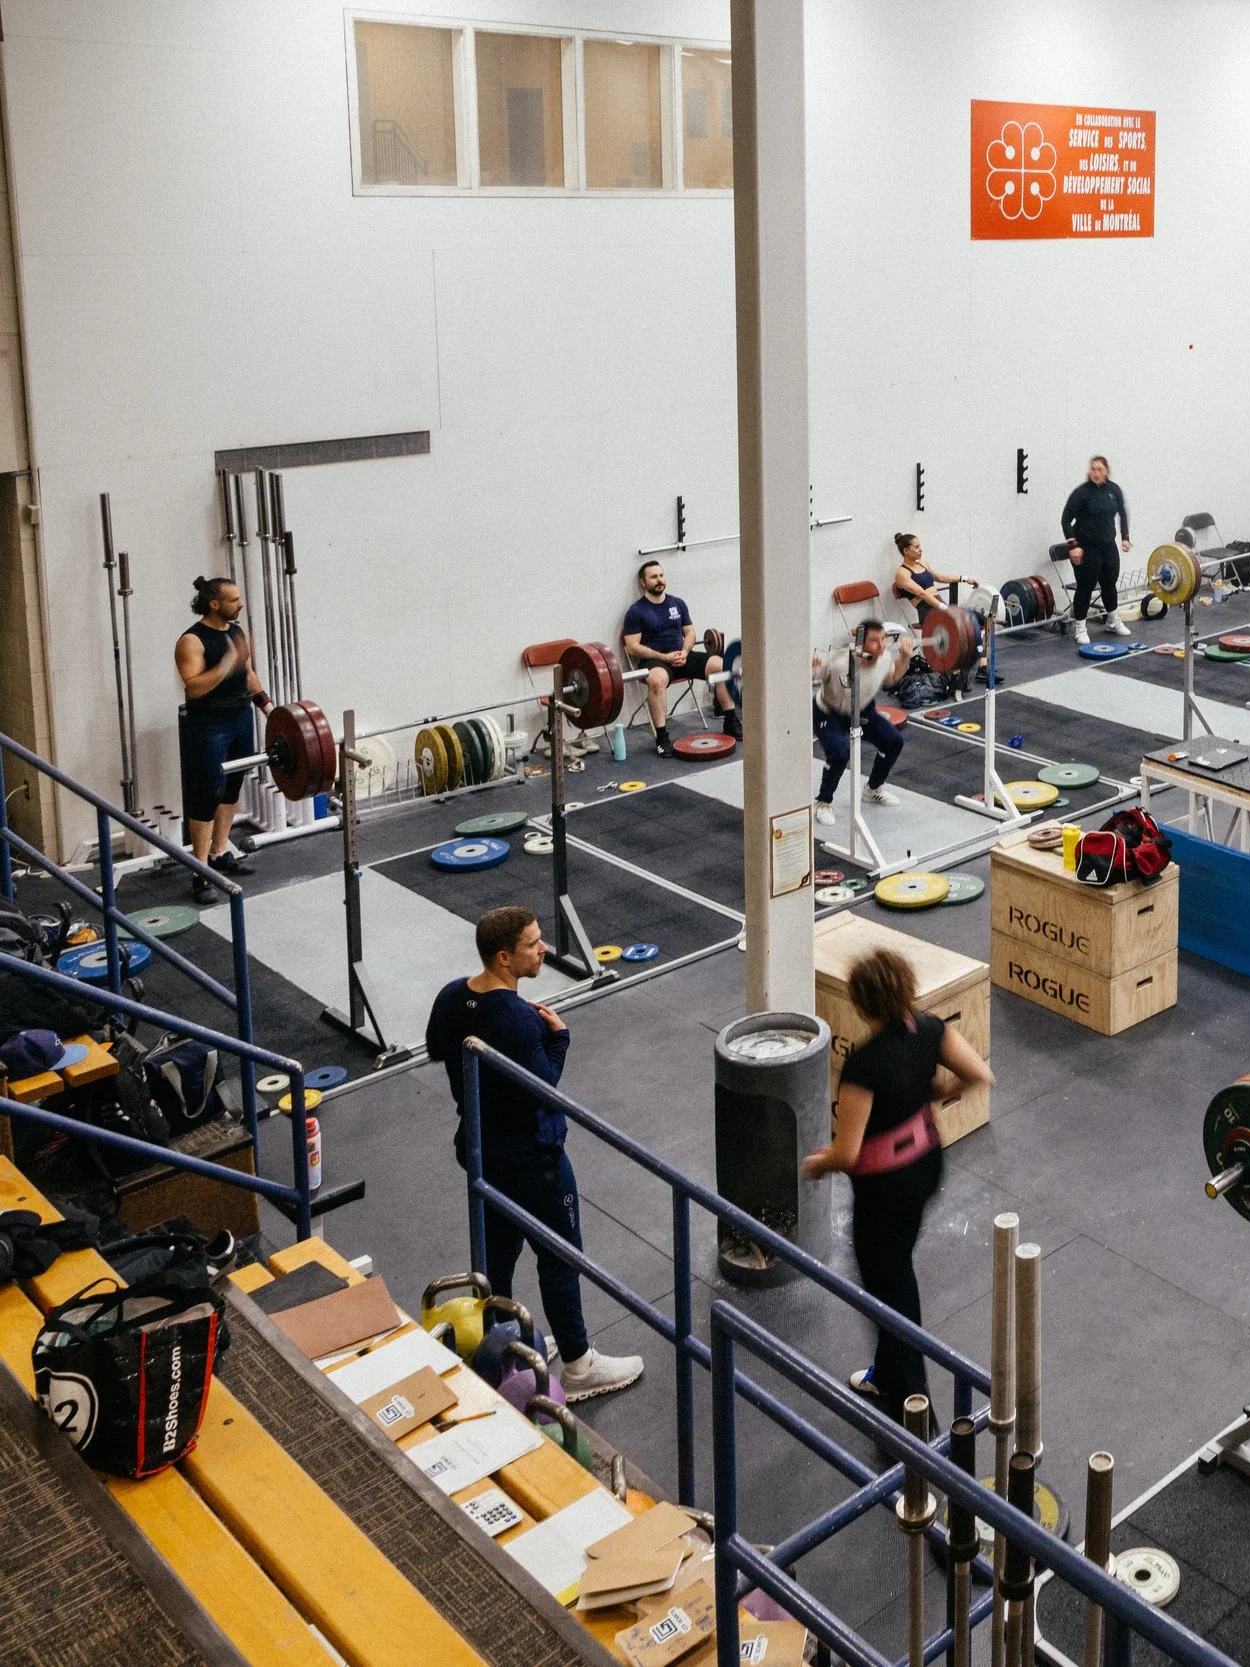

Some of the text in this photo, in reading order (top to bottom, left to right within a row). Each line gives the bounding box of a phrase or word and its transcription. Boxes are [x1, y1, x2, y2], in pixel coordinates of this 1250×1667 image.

[1068, 128, 1147, 151] SERVICE DES SPORTS,
[1090, 153, 1120, 174] LOISIRS,
[1063, 171, 1151, 194] DÉVELOPPEMENT SOCIAL
[1108, 199, 1114, 211] LA
[1072, 214, 1092, 232] VILLE
[1103, 209, 1140, 232] MONTRÉAL
[1009, 905, 1090, 956] ROGUE
[1009, 961, 1090, 1014] ROGUE
[162, 1346, 181, 1454] B2Shoes.com
